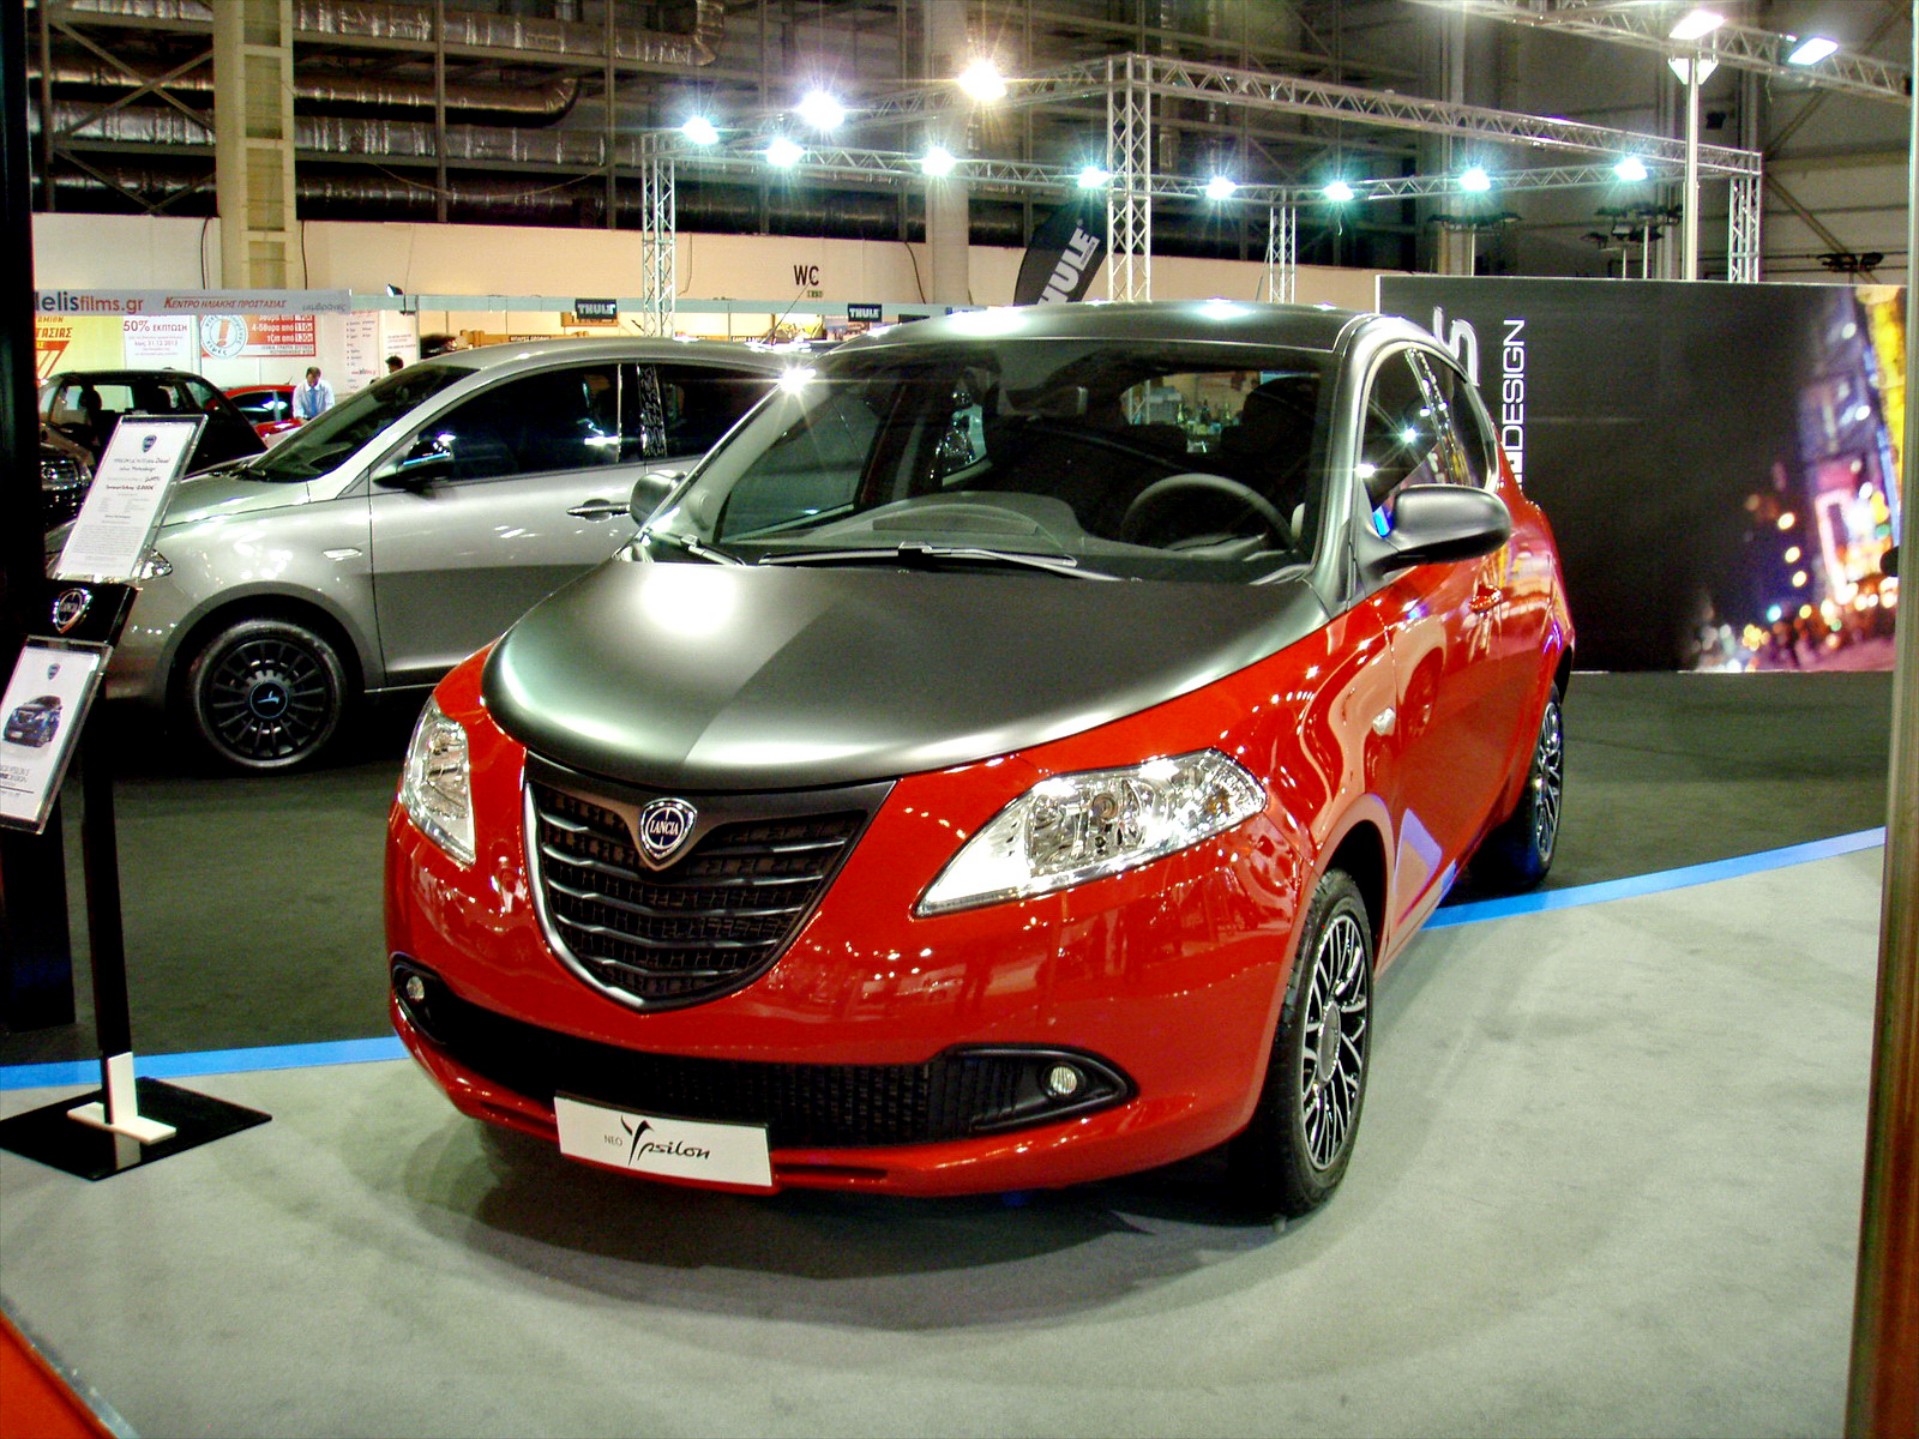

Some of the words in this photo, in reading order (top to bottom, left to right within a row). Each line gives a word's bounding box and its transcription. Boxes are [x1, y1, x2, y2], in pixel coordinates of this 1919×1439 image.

[1037, 228, 1100, 304] HULE
[793, 264, 819, 286] WC
[577, 303, 616, 315] THULE
[849, 309, 881, 319] THULE
[123, 320, 150, 332] 50%
[153, 324, 188, 332] ΕΚΠΤΩΣΗ
[649, 820, 679, 835] LANCIA
[604, 1135, 623, 1146] NEO
[620, 1114, 710, 1167] Ypsilon
